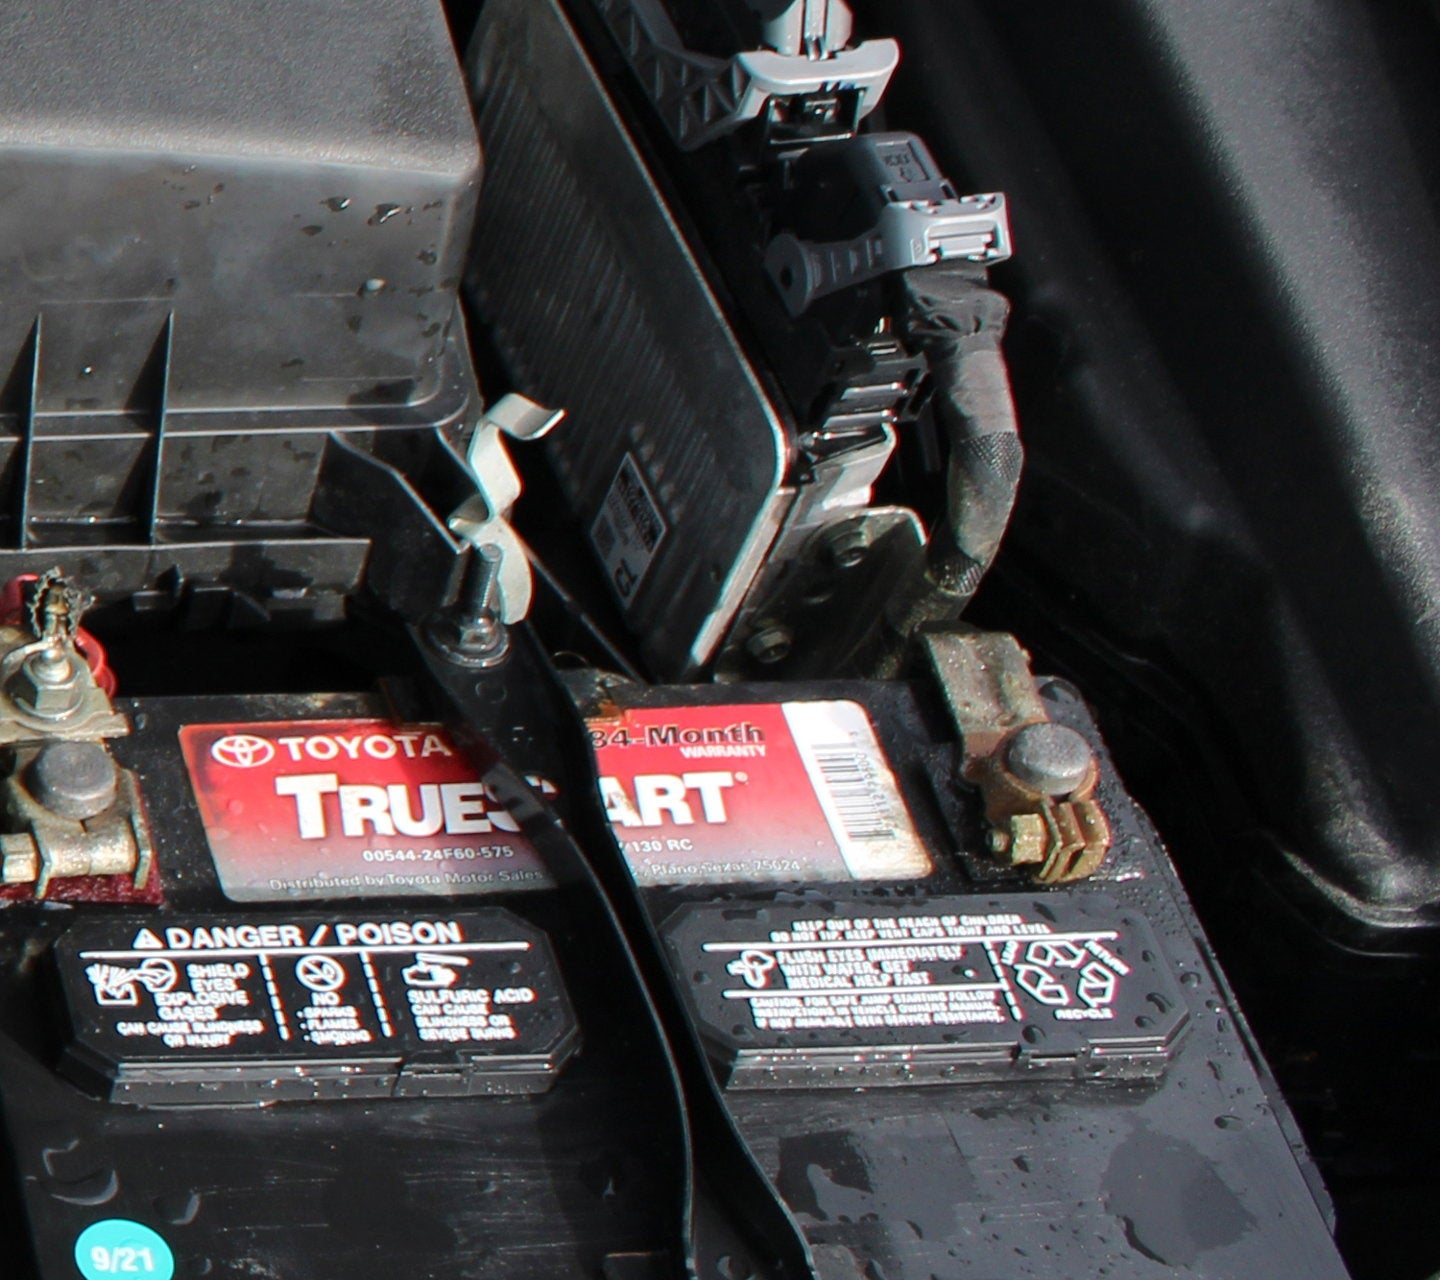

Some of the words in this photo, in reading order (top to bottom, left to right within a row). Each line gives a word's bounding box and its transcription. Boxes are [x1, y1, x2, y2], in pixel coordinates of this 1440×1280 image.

[277, 734, 453, 762] TOYOTA
[679, 743, 767, 759] WARRANTY
[666, 837, 694, 852] RC
[385, 873, 441, 888] Toyota
[165, 924, 306, 950] DANGER
[334, 920, 465, 947] POISON
[776, 950, 826, 964] FLUSH
[826, 949, 866, 963] EYES
[866, 946, 962, 962] IMMEDIATELY
[187, 962, 250, 979] SHIELD
[780, 963, 823, 977] WITH
[880, 960, 911, 974] GET
[190, 977, 238, 993] EYES
[786, 975, 854, 990] MEDICAL
[853, 973, 893, 988] HELP
[893, 972, 932, 987] FAST
[154, 991, 250, 1008] EXPLOSIVE
[311, 991, 340, 1006] NO
[407, 989, 490, 1005] SULFURIC
[493, 987, 535, 1004] ACID
[158, 1006, 219, 1021] GASES
[90, 1244, 155, 1275] 9/21
